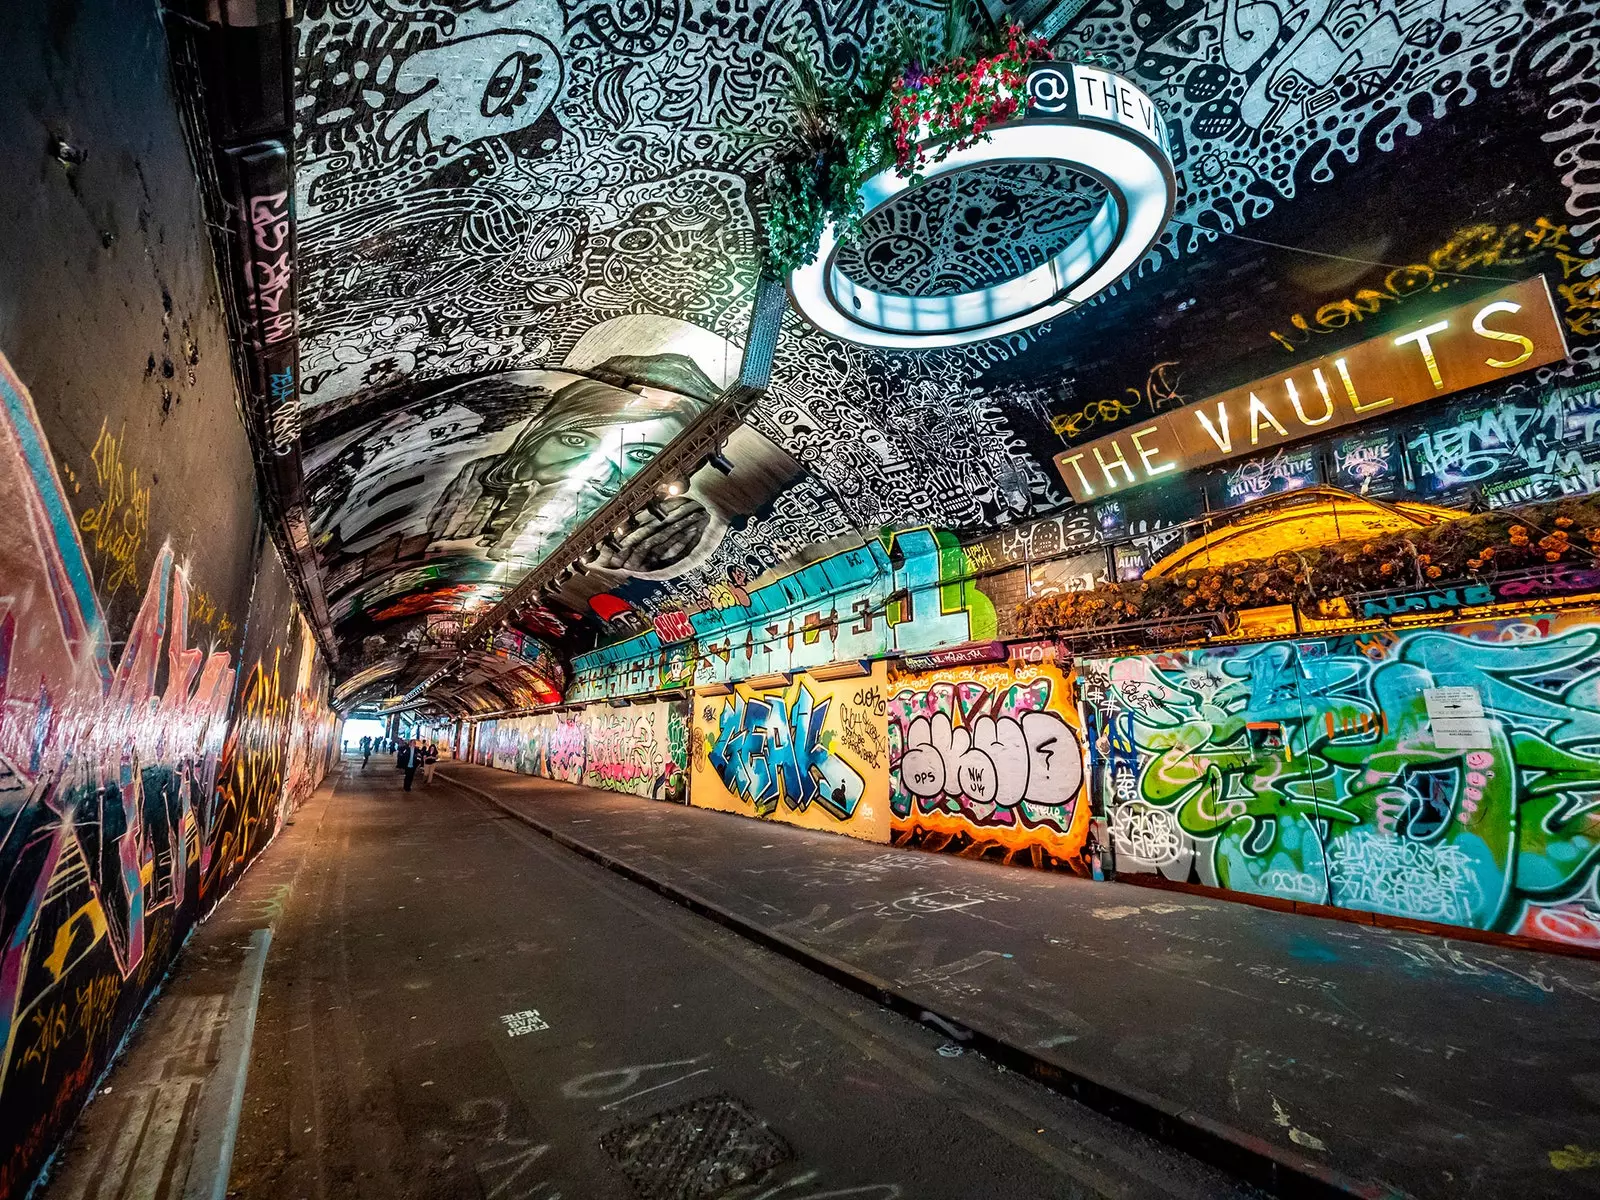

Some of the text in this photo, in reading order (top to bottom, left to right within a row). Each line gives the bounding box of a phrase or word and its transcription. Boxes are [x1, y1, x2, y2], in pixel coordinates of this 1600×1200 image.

[1062, 425, 1177, 497] THE
[1193, 299, 1536, 456] VAULTS
[1274, 457, 1314, 479] ALIVE
[1229, 475, 1270, 498] ALIVE
[1488, 480, 1549, 510] ALIVE
[914, 772, 936, 784] DPS
[967, 767, 985, 782] NW
